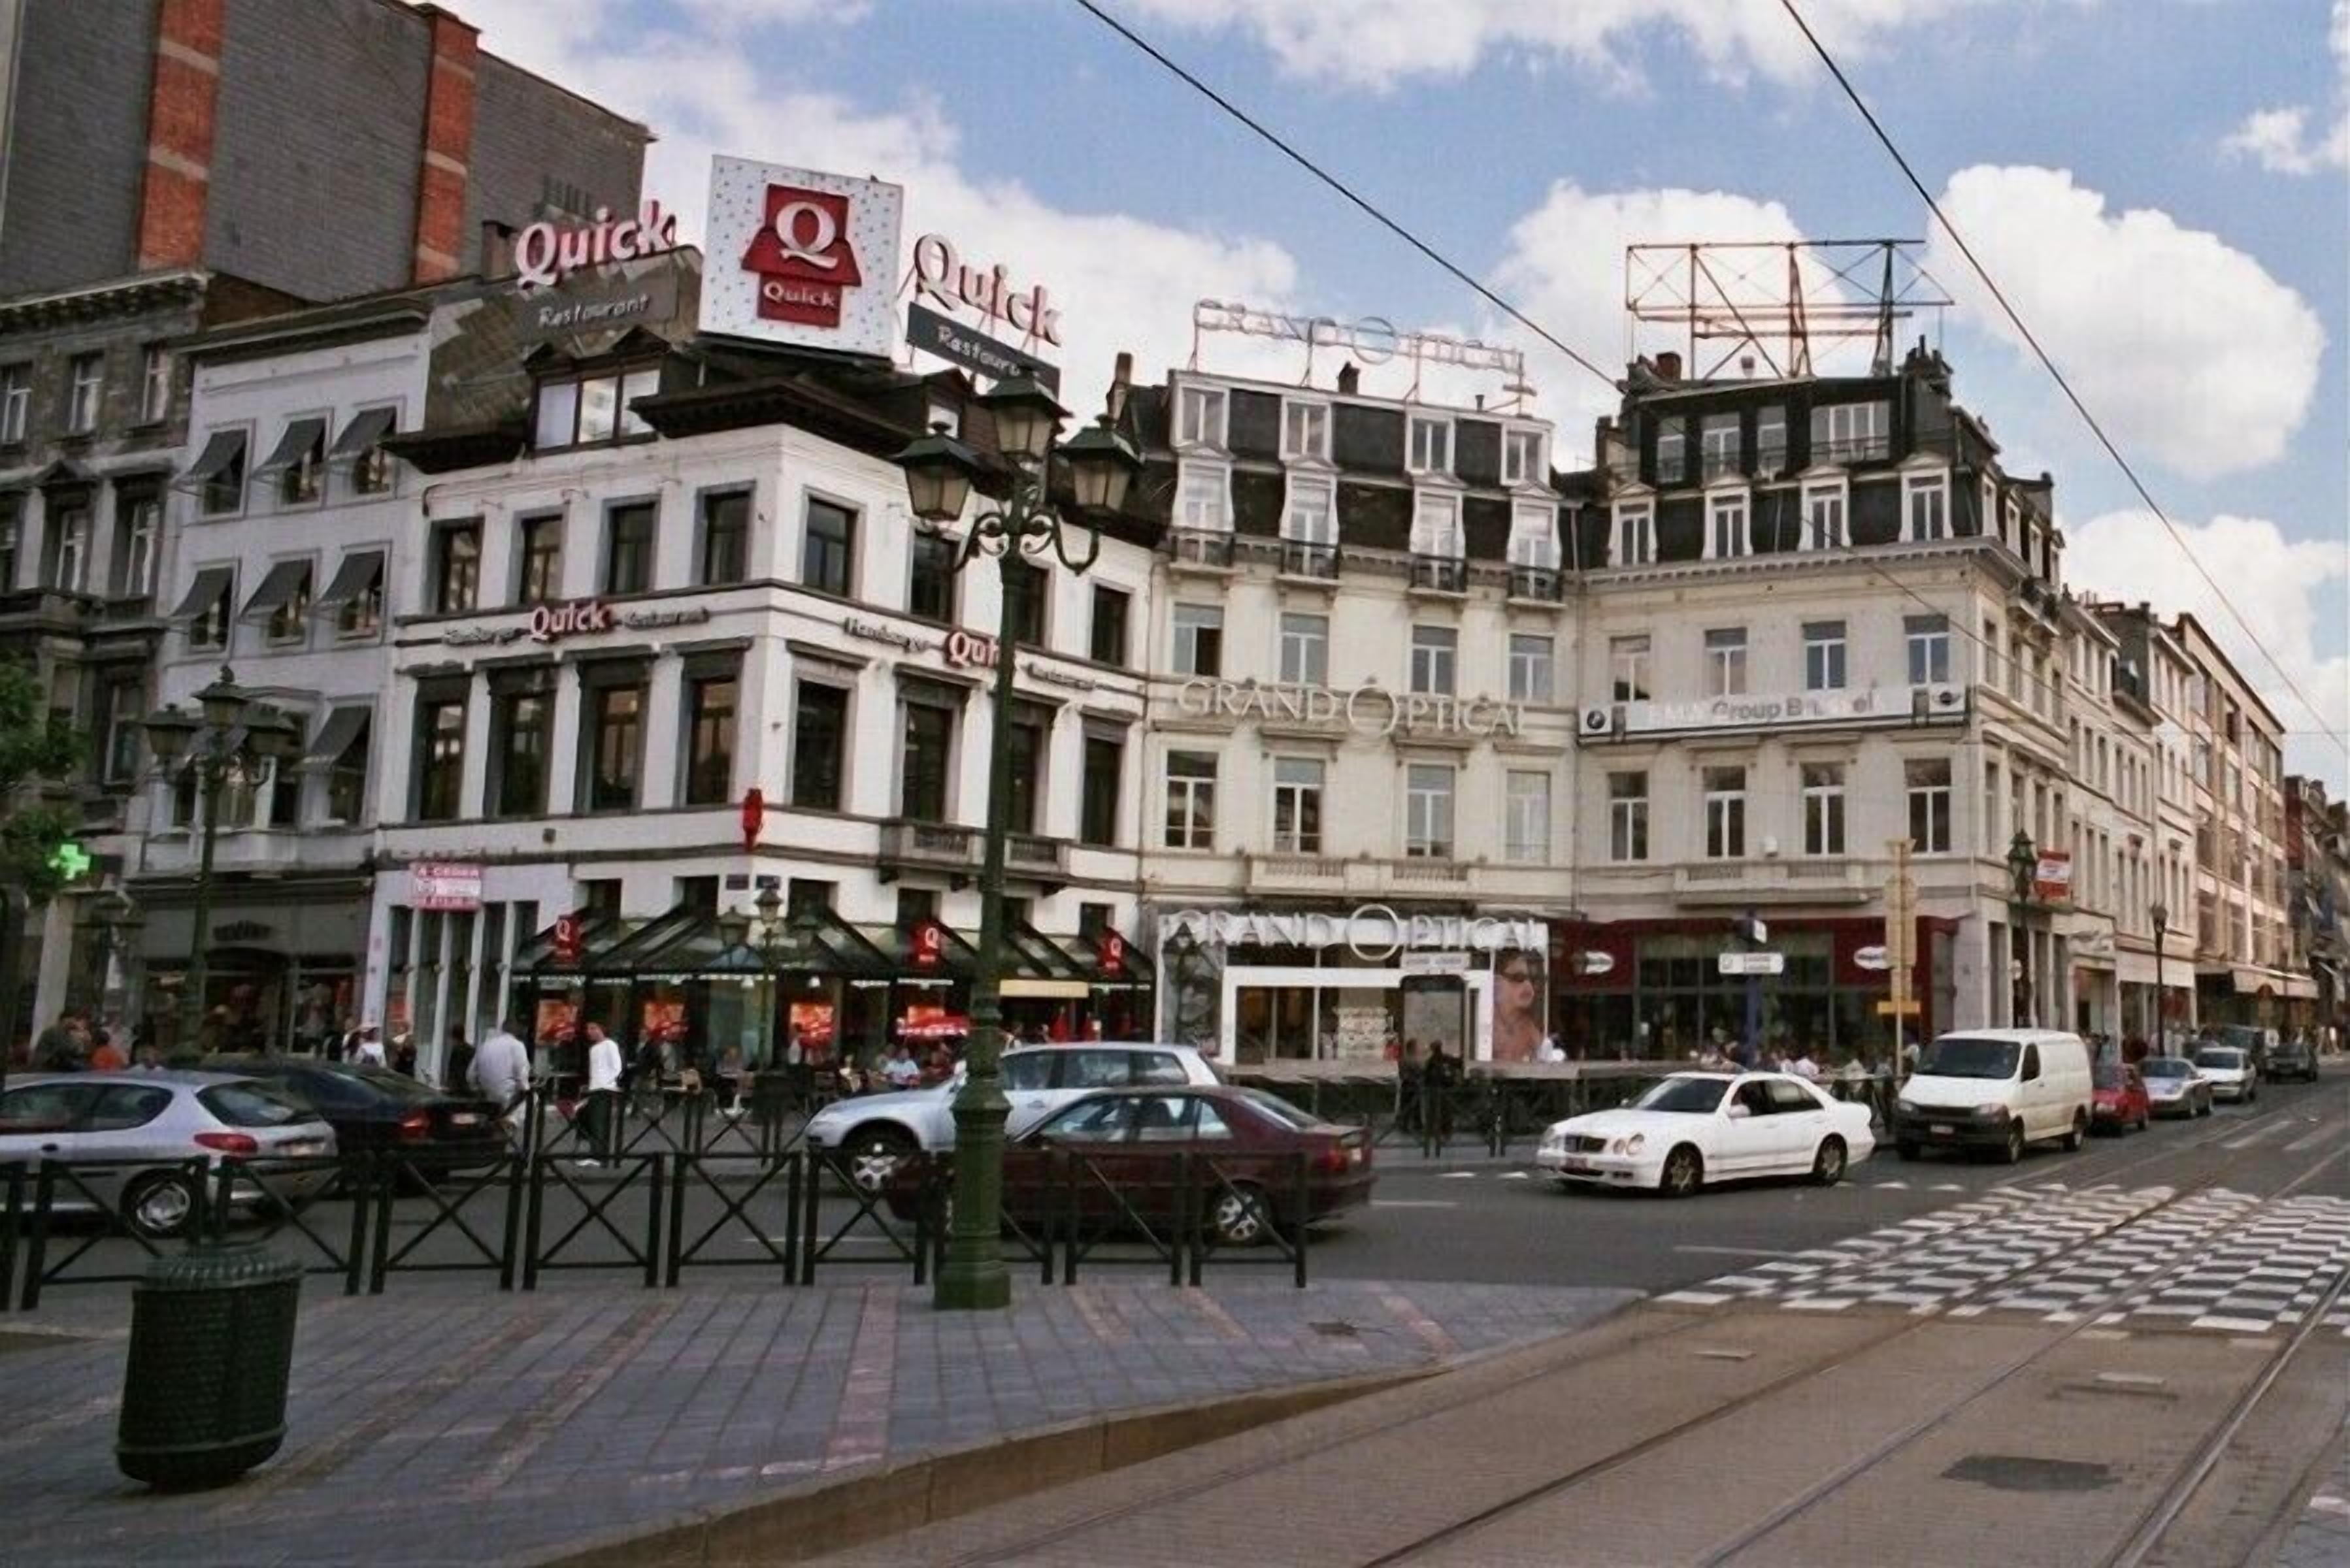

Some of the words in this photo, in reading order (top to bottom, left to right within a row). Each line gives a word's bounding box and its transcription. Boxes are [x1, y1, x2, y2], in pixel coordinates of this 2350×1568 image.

[515, 199, 676, 286] Quick
[776, 201, 838, 269] Q
[763, 281, 835, 306] Quick
[914, 233, 1063, 348] Quick
[529, 601, 609, 640] Quick
[557, 919, 570, 941] Q
[925, 928, 939, 949] Q
